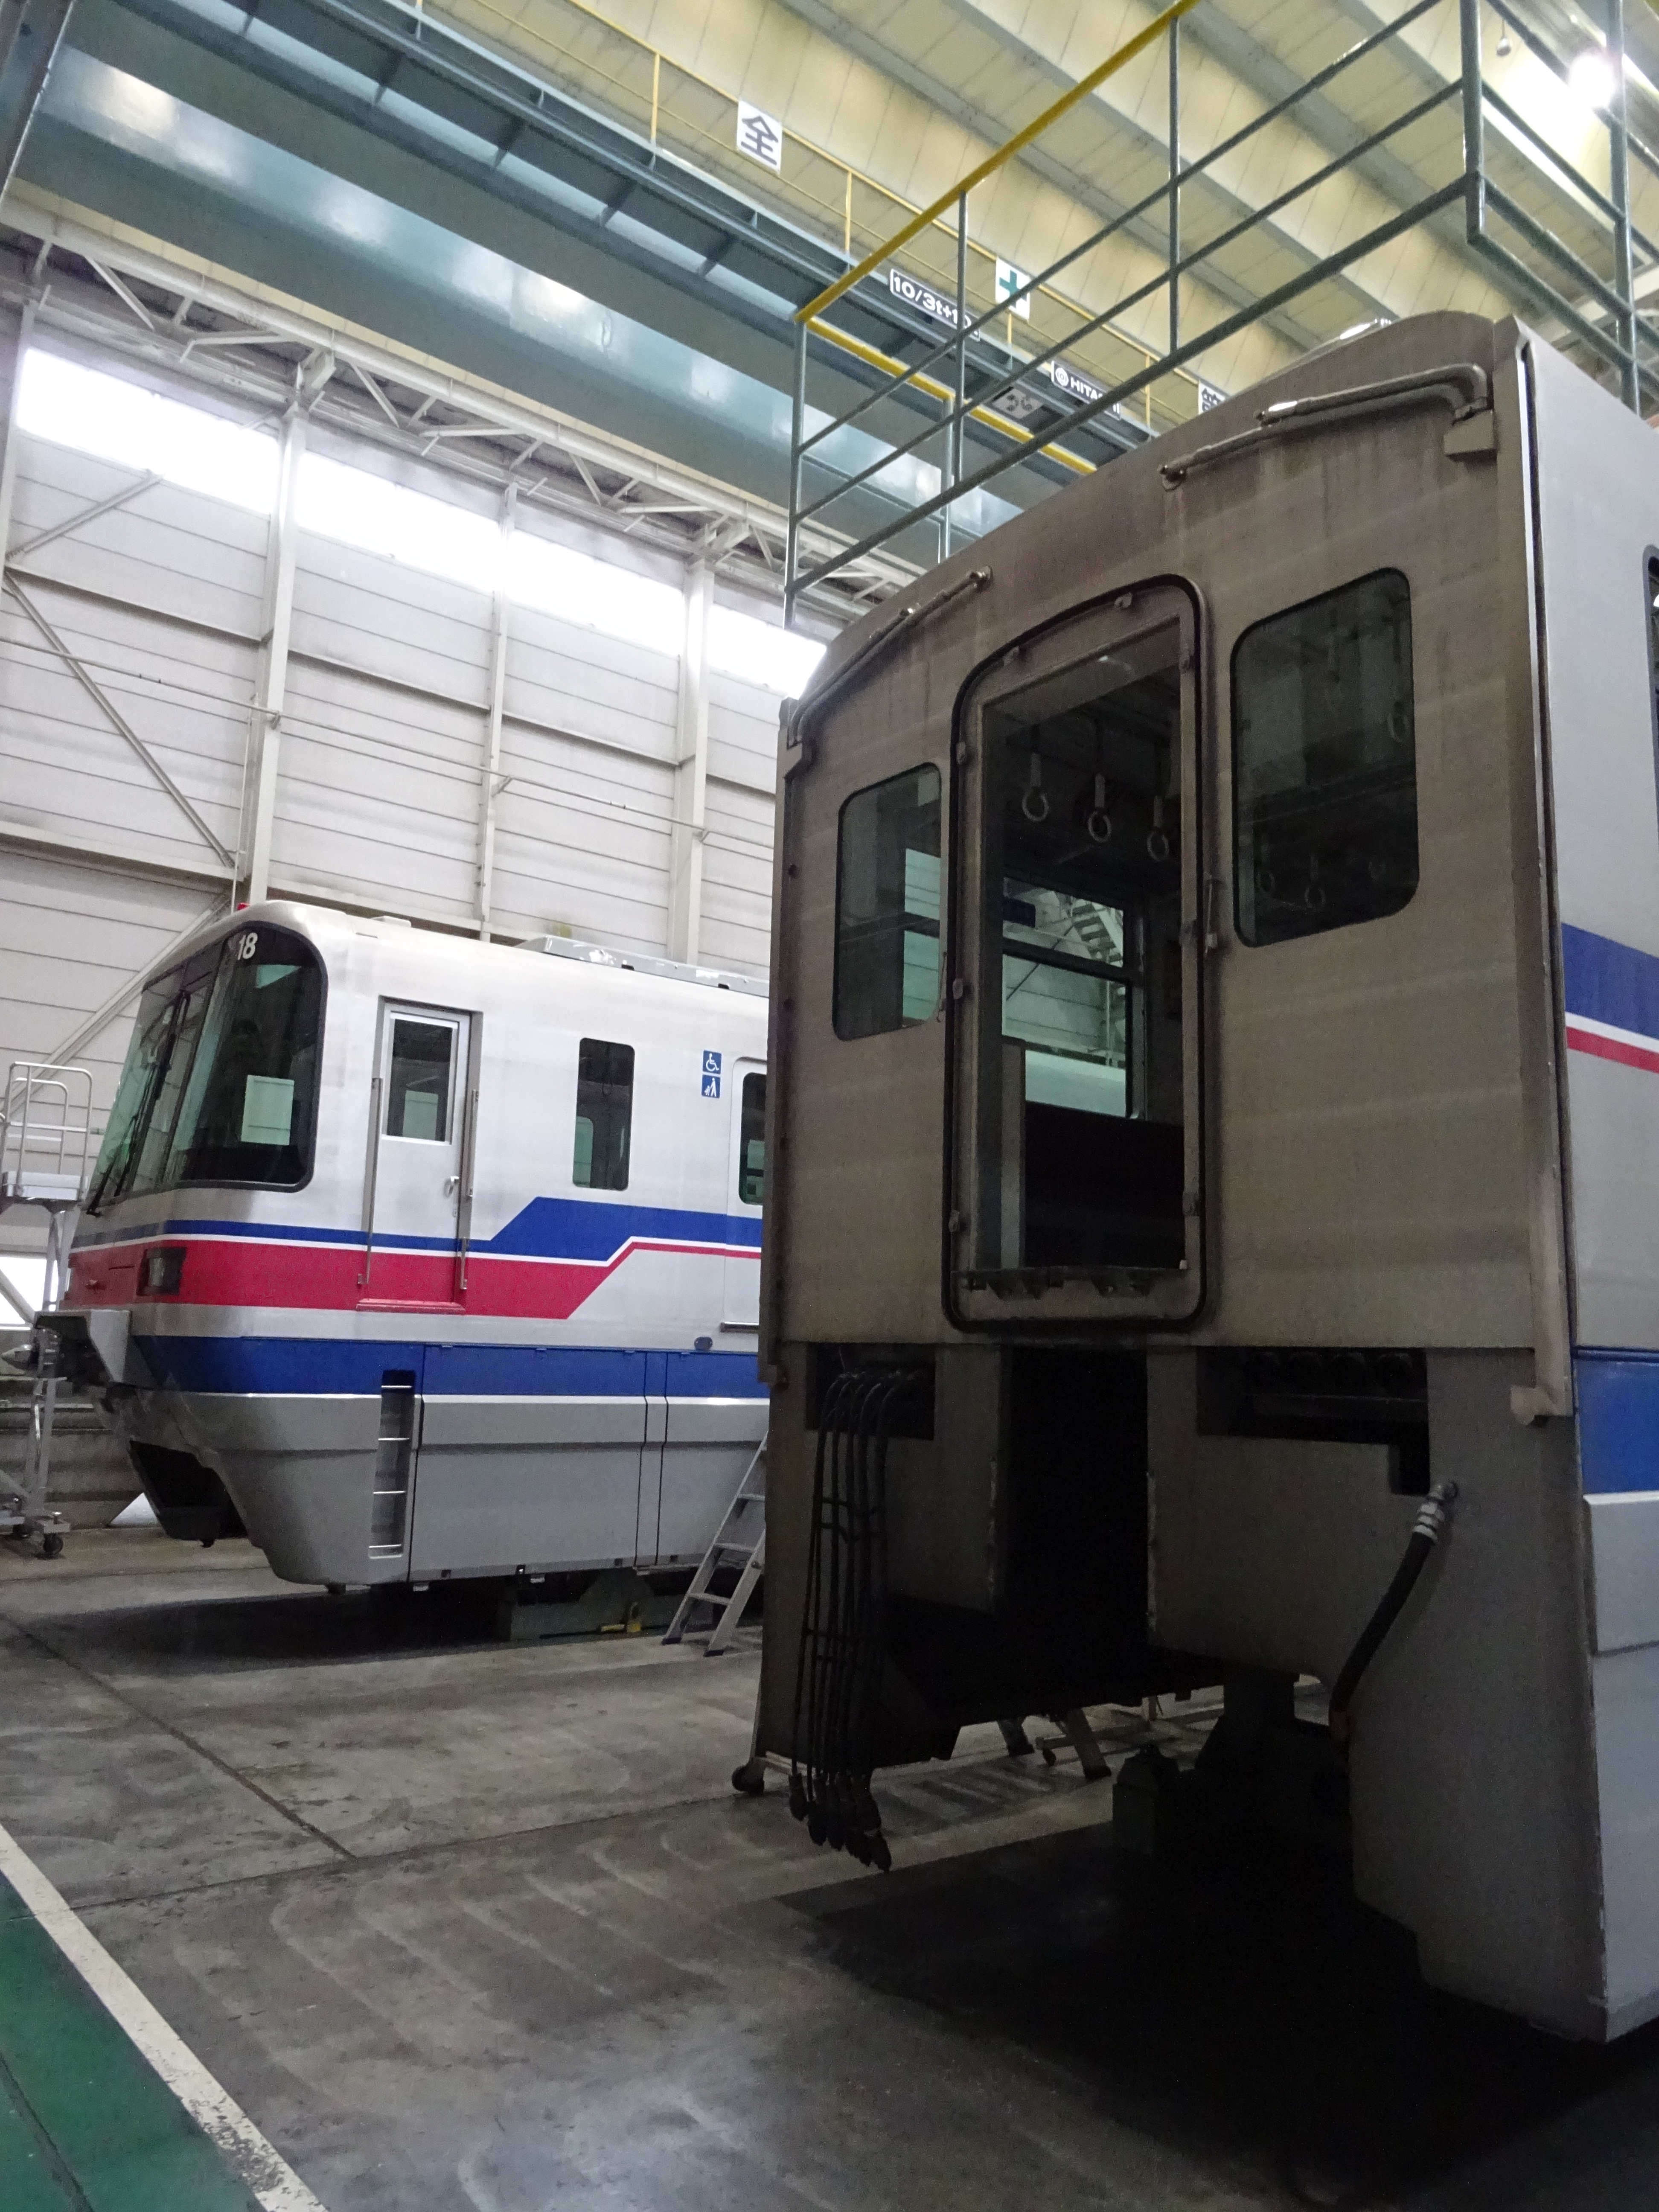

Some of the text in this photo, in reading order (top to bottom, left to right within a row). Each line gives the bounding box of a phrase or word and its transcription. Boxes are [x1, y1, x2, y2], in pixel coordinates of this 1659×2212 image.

[740, 115, 779, 166] 全
[1070, 376, 1120, 414] HITAI
[237, 932, 258, 960] 18
